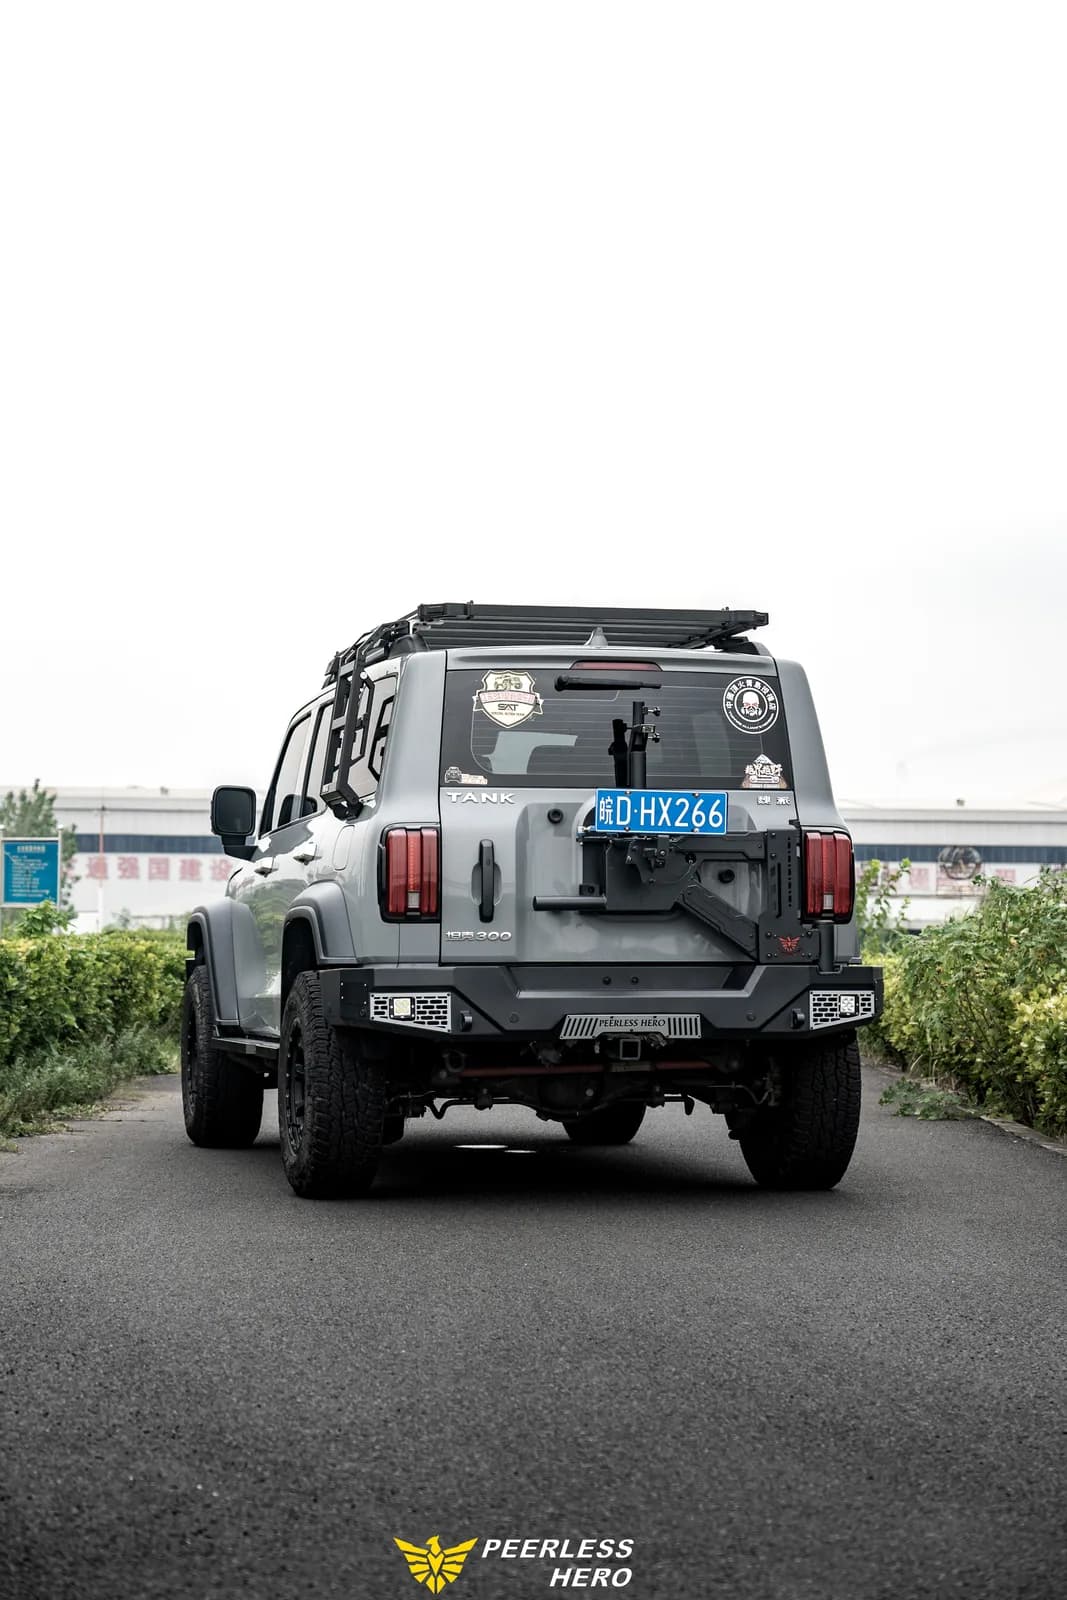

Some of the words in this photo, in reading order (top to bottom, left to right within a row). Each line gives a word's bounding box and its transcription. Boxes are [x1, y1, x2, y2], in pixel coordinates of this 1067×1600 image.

[447, 792, 515, 804] TANK
[600, 1019, 638, 1027] PEERLESS
[641, 1019, 666, 1027] HERO
